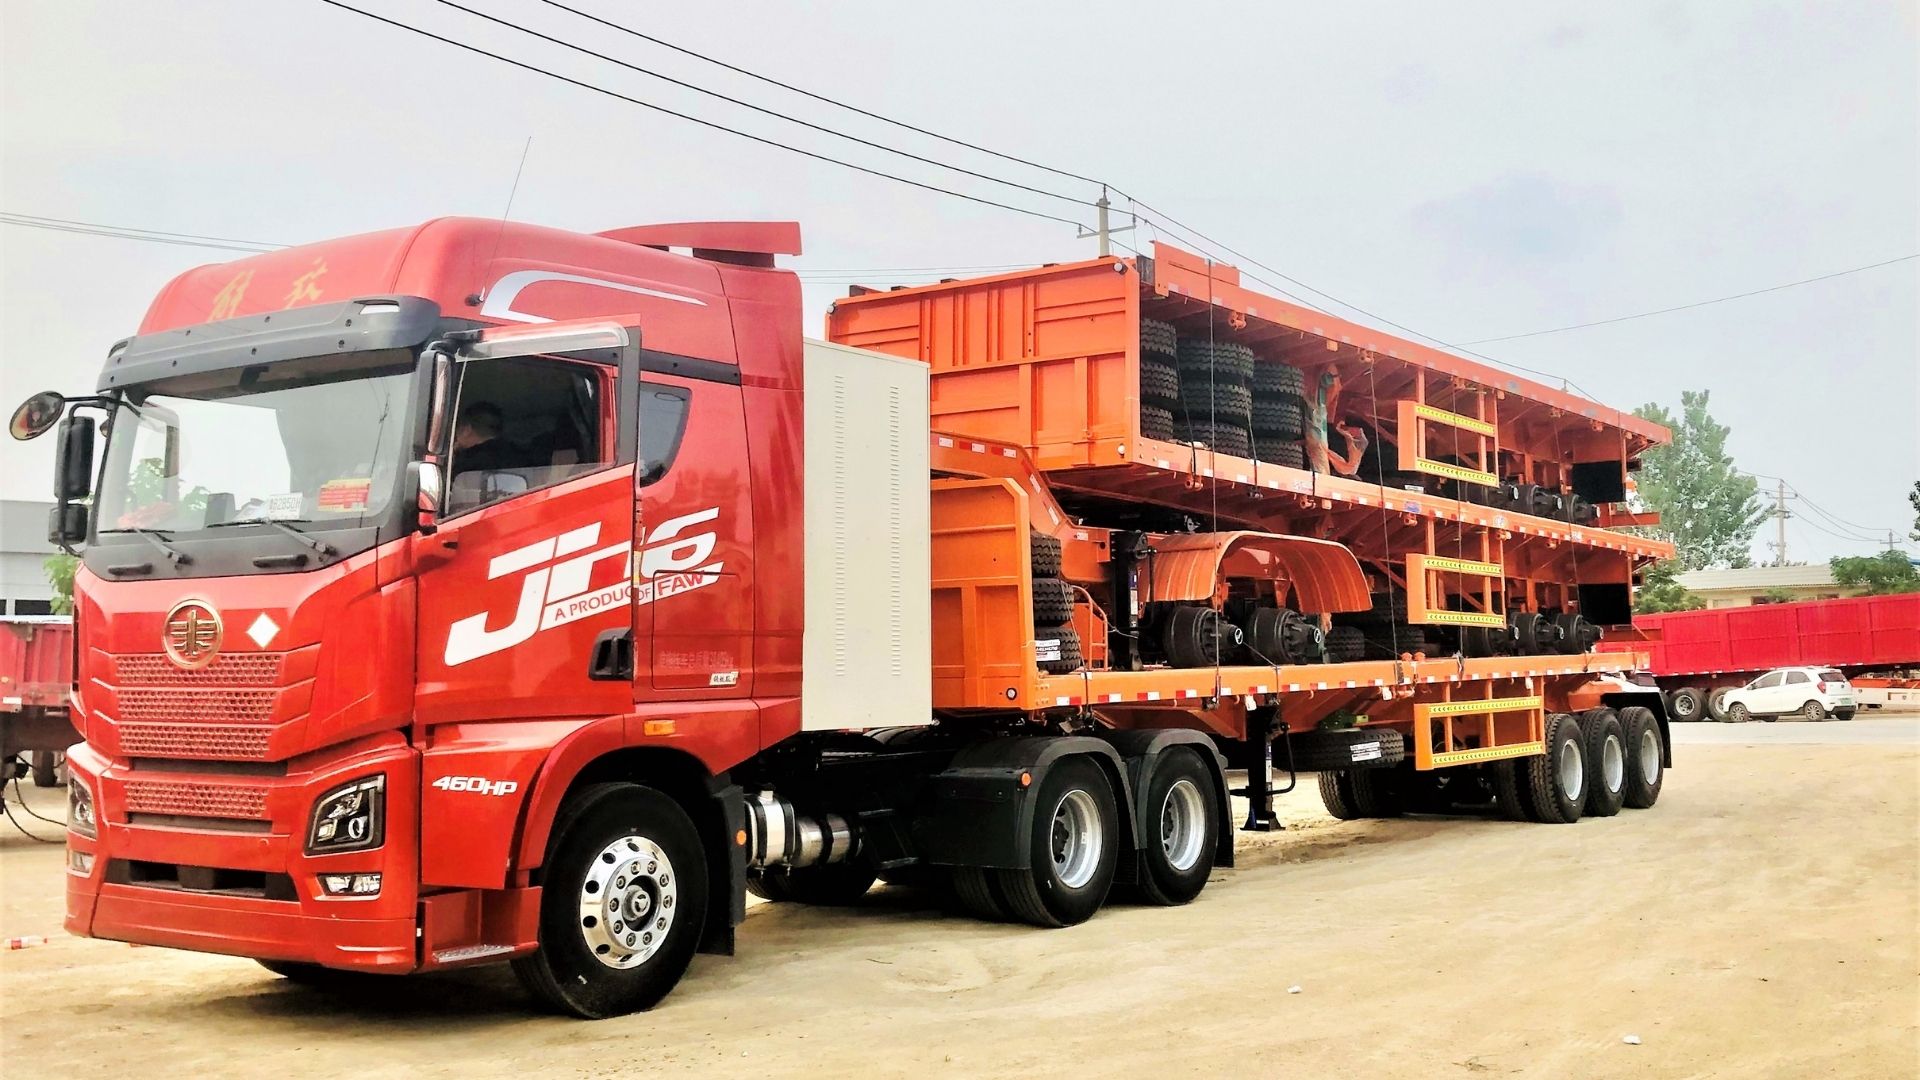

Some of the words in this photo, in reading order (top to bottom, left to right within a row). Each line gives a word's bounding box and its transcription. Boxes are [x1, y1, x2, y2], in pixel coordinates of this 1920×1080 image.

[555, 607, 566, 621] A
[569, 585, 633, 616] PRODUC
[657, 570, 705, 596] FAW
[431, 775, 518, 796] 460HP
